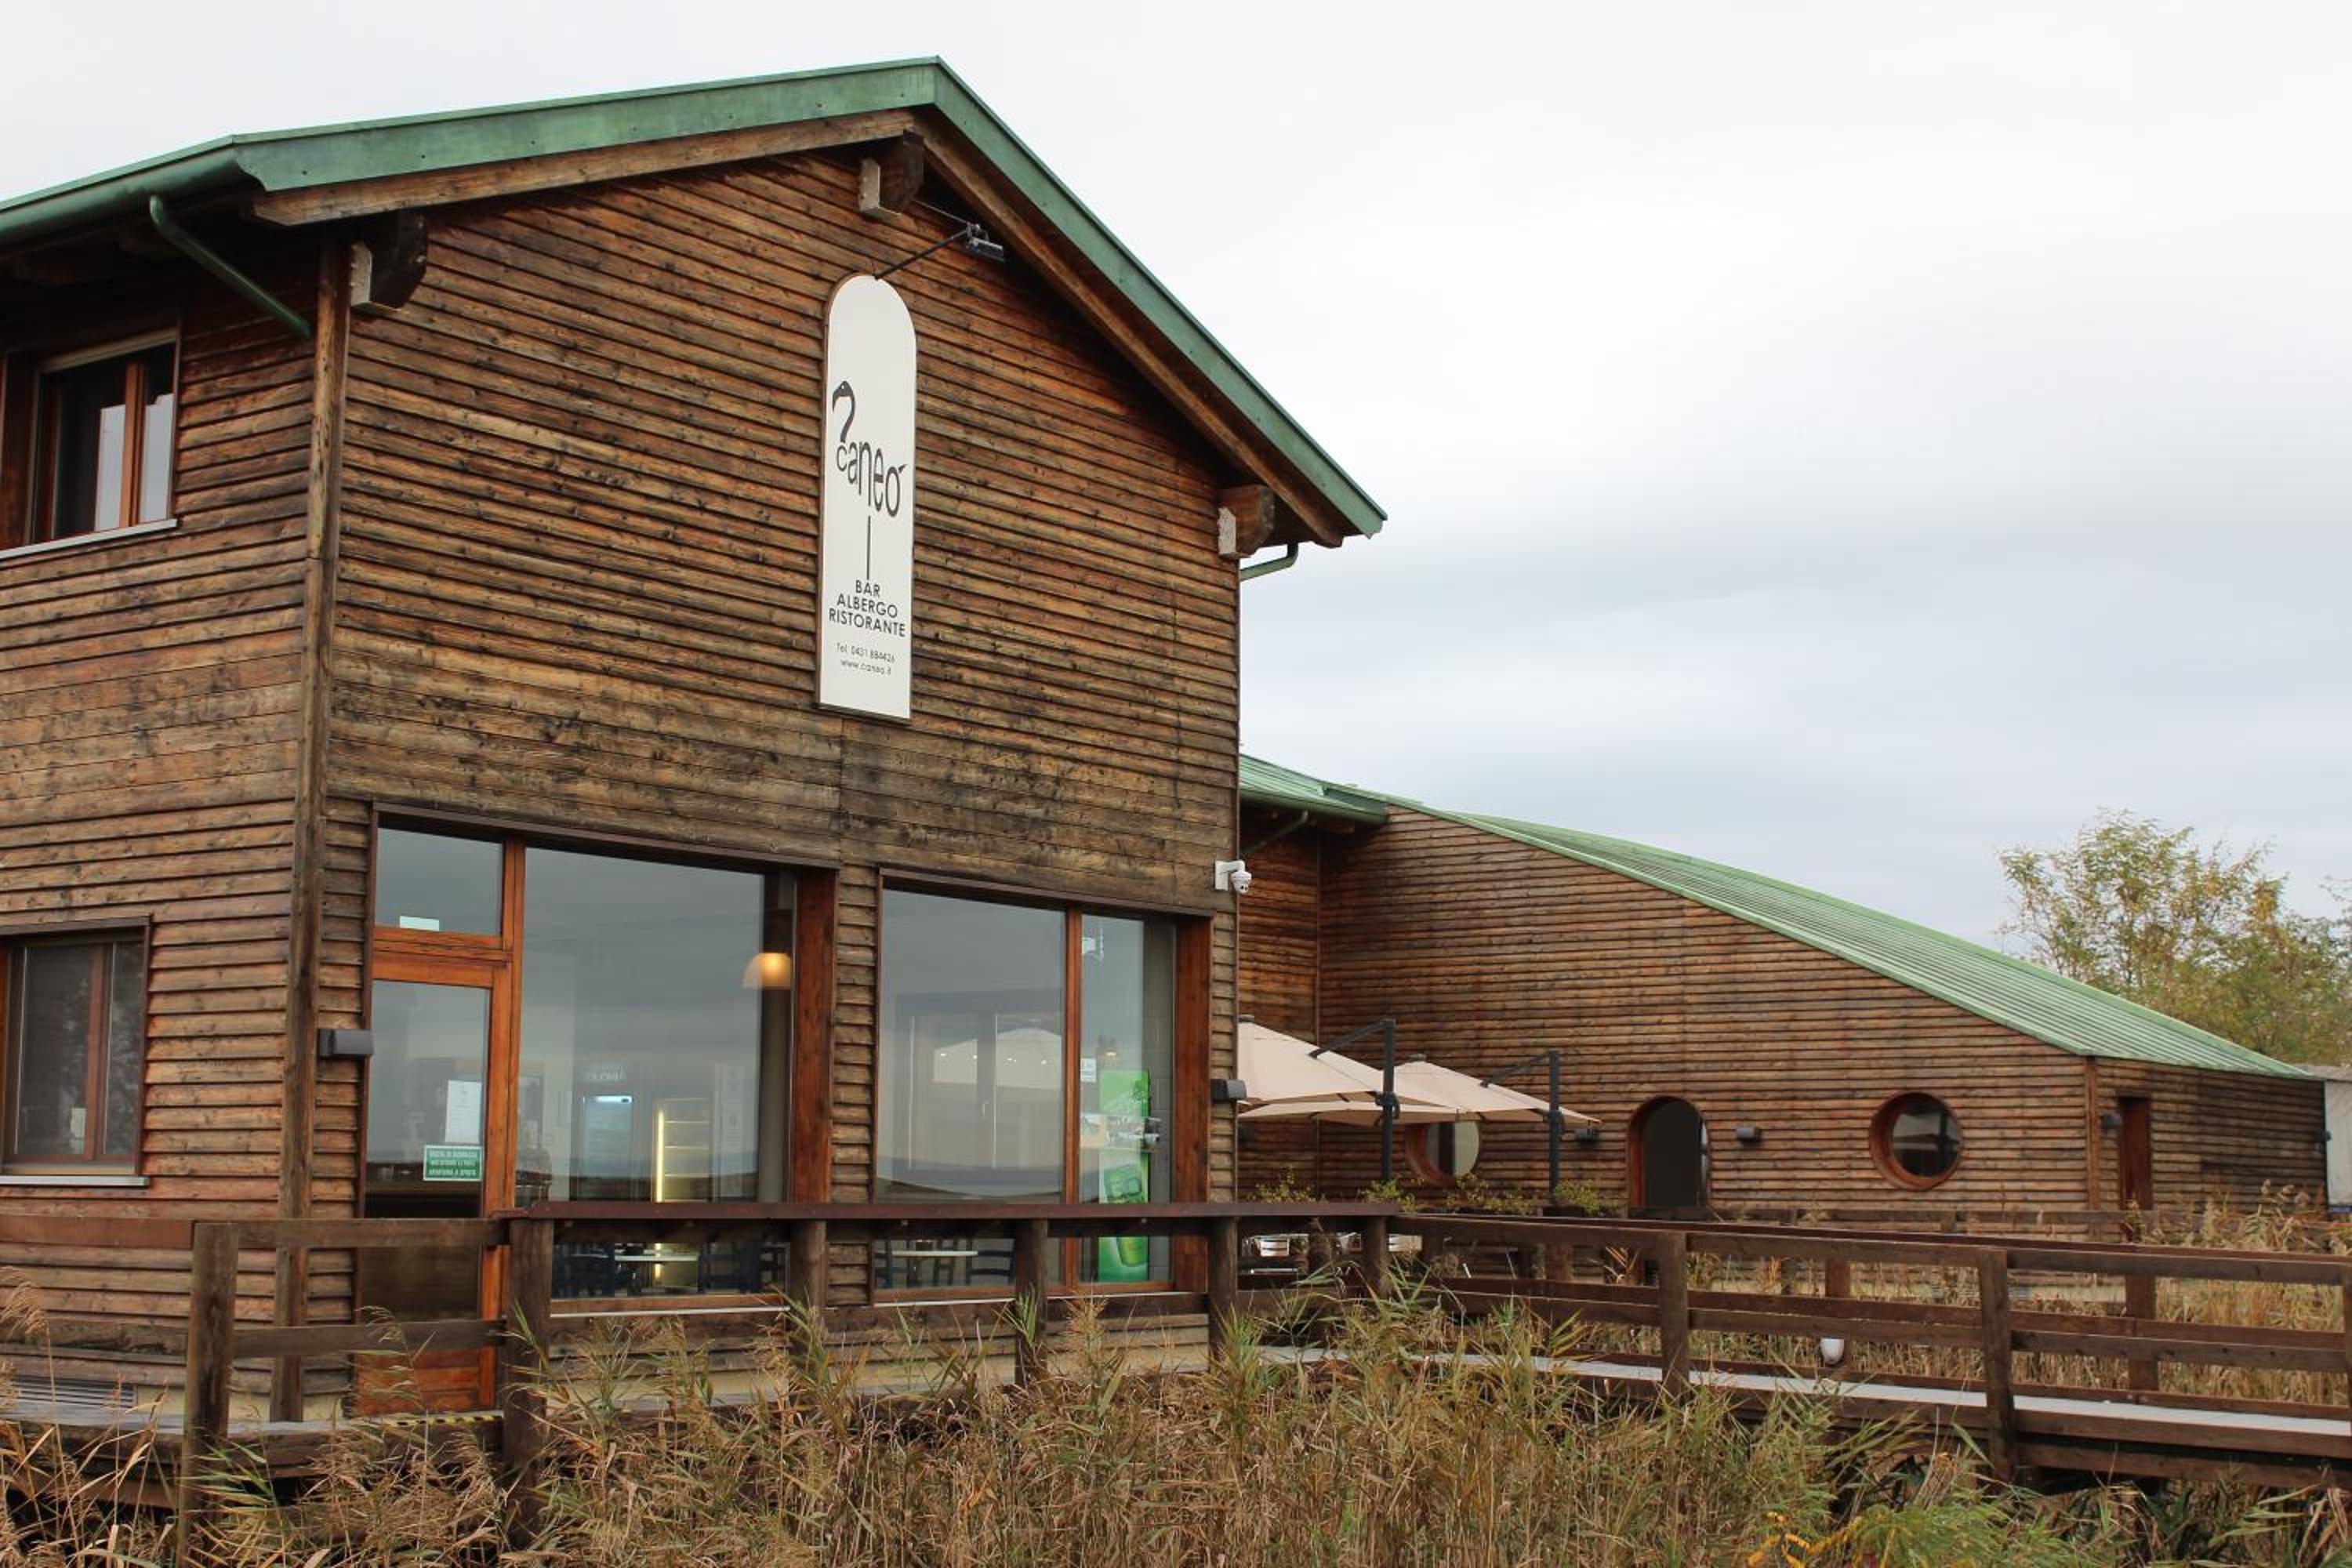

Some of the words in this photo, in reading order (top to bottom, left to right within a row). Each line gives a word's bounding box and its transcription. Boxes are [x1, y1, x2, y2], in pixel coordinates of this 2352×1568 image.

[855, 579, 880, 597] BAR
[837, 593, 898, 619] ALBERGO
[829, 608, 906, 637] RISTORANTE
